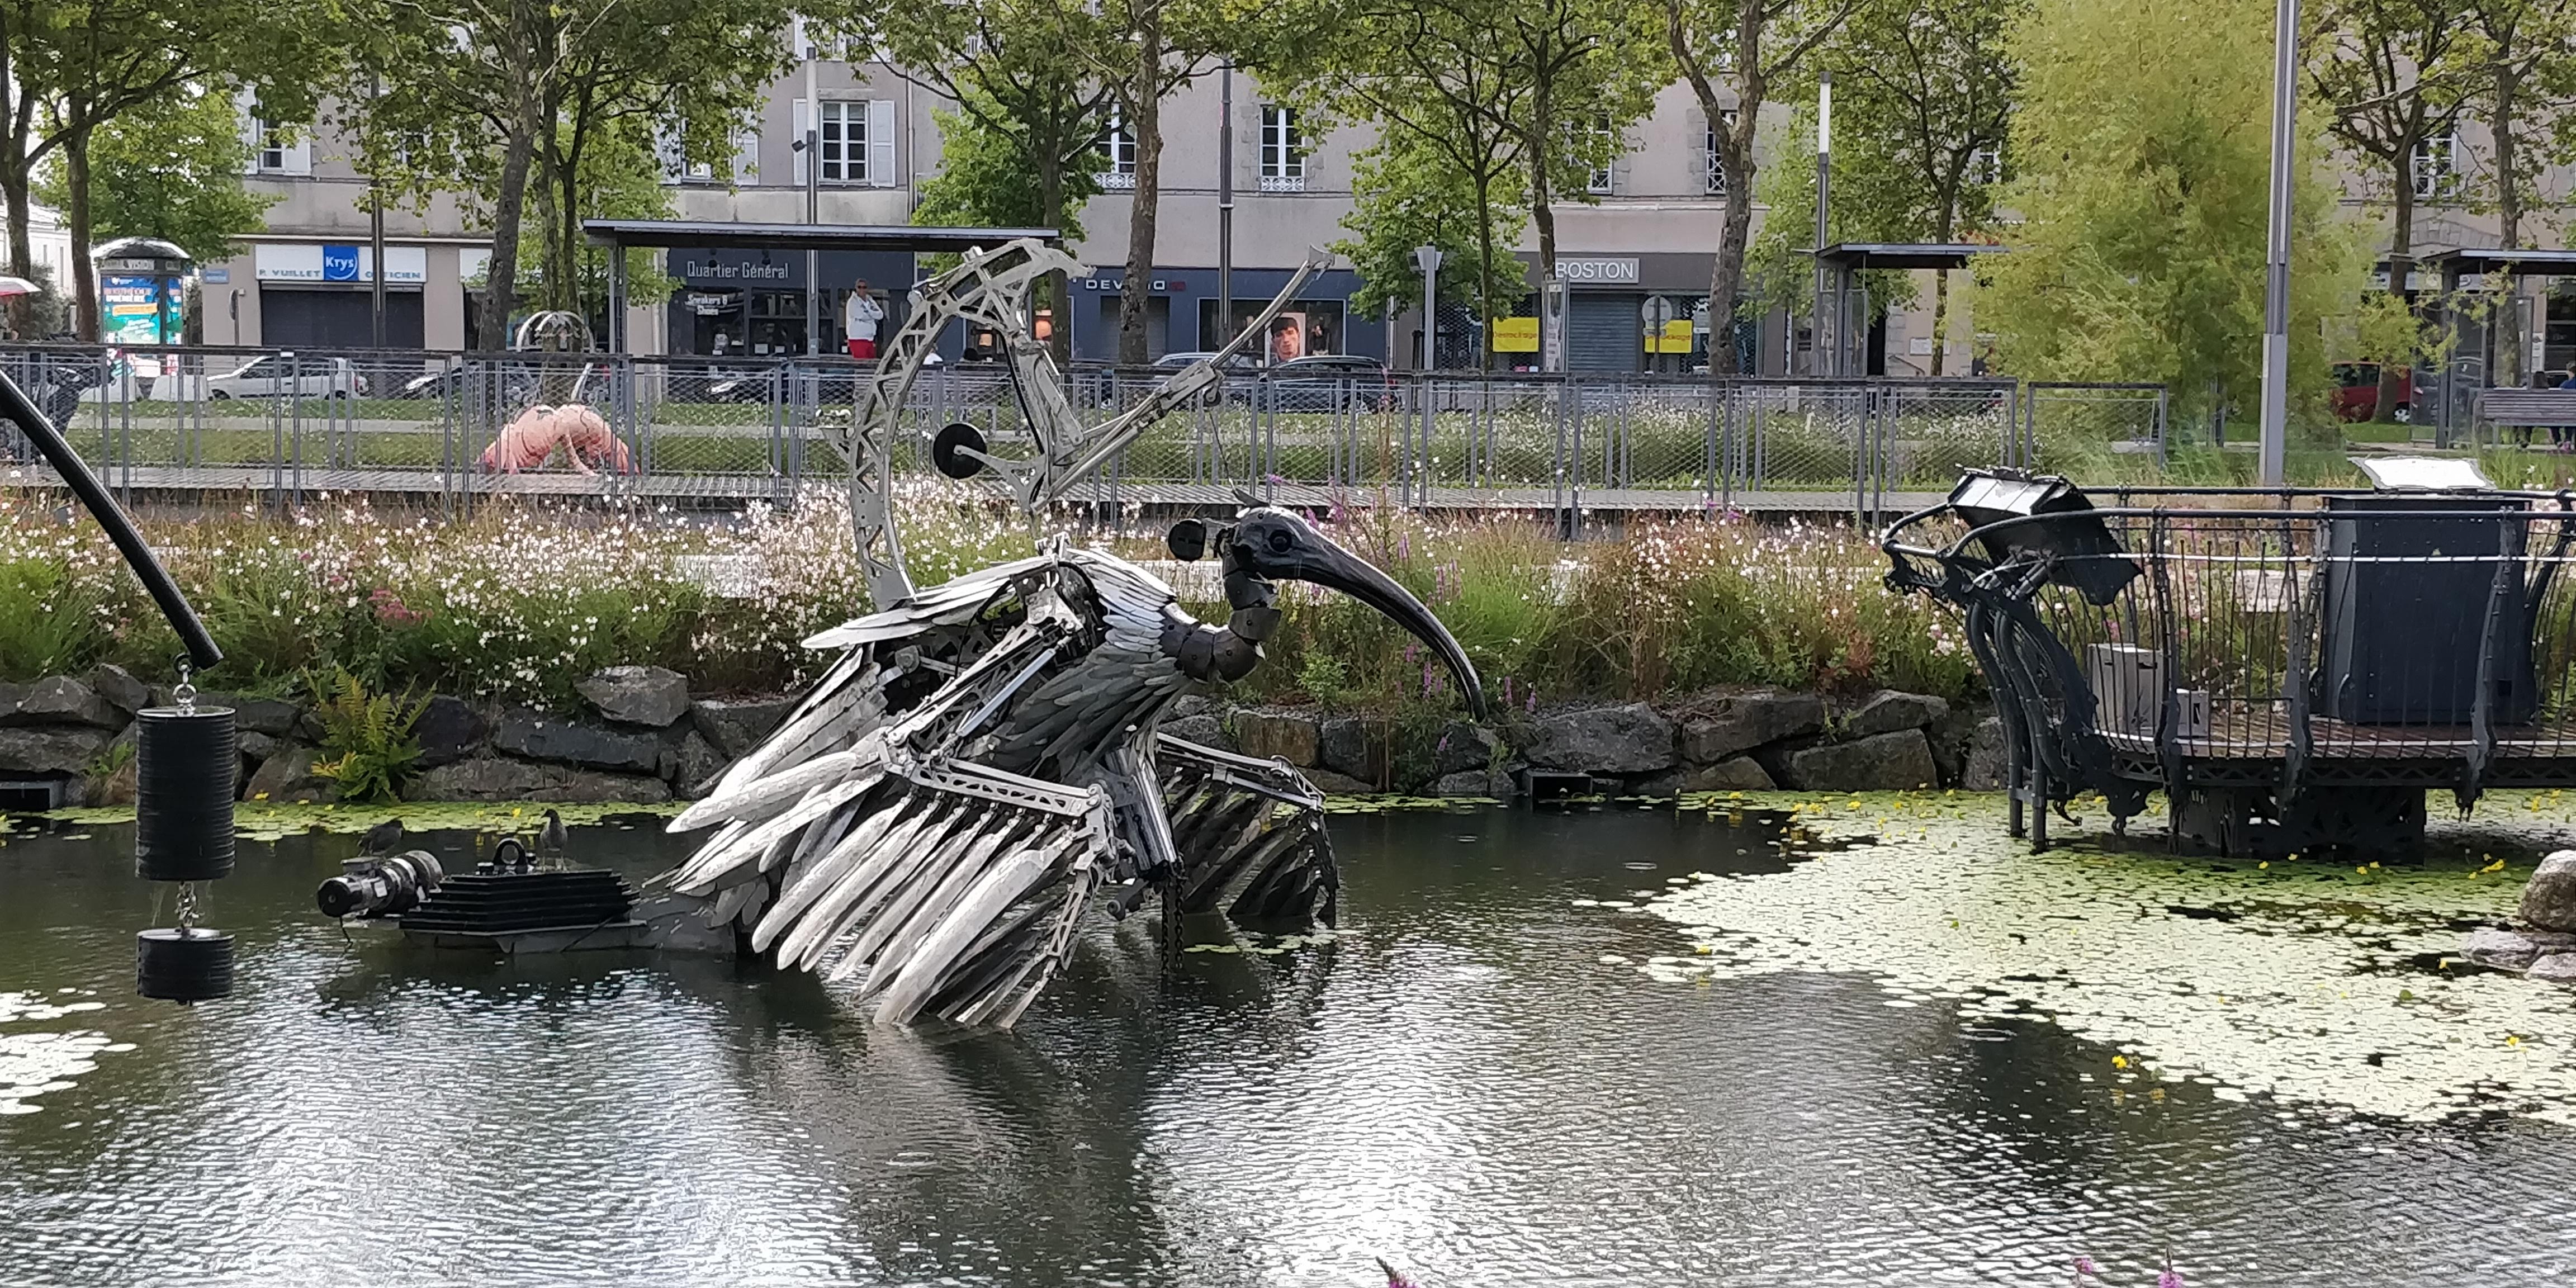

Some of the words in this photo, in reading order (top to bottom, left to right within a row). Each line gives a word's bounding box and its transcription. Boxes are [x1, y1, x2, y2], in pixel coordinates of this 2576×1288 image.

[326, 256, 354, 272] Krys
[687, 261, 738, 277] Quartier
[742, 262, 788, 279] Général
[1555, 262, 1633, 278] BOSTON
